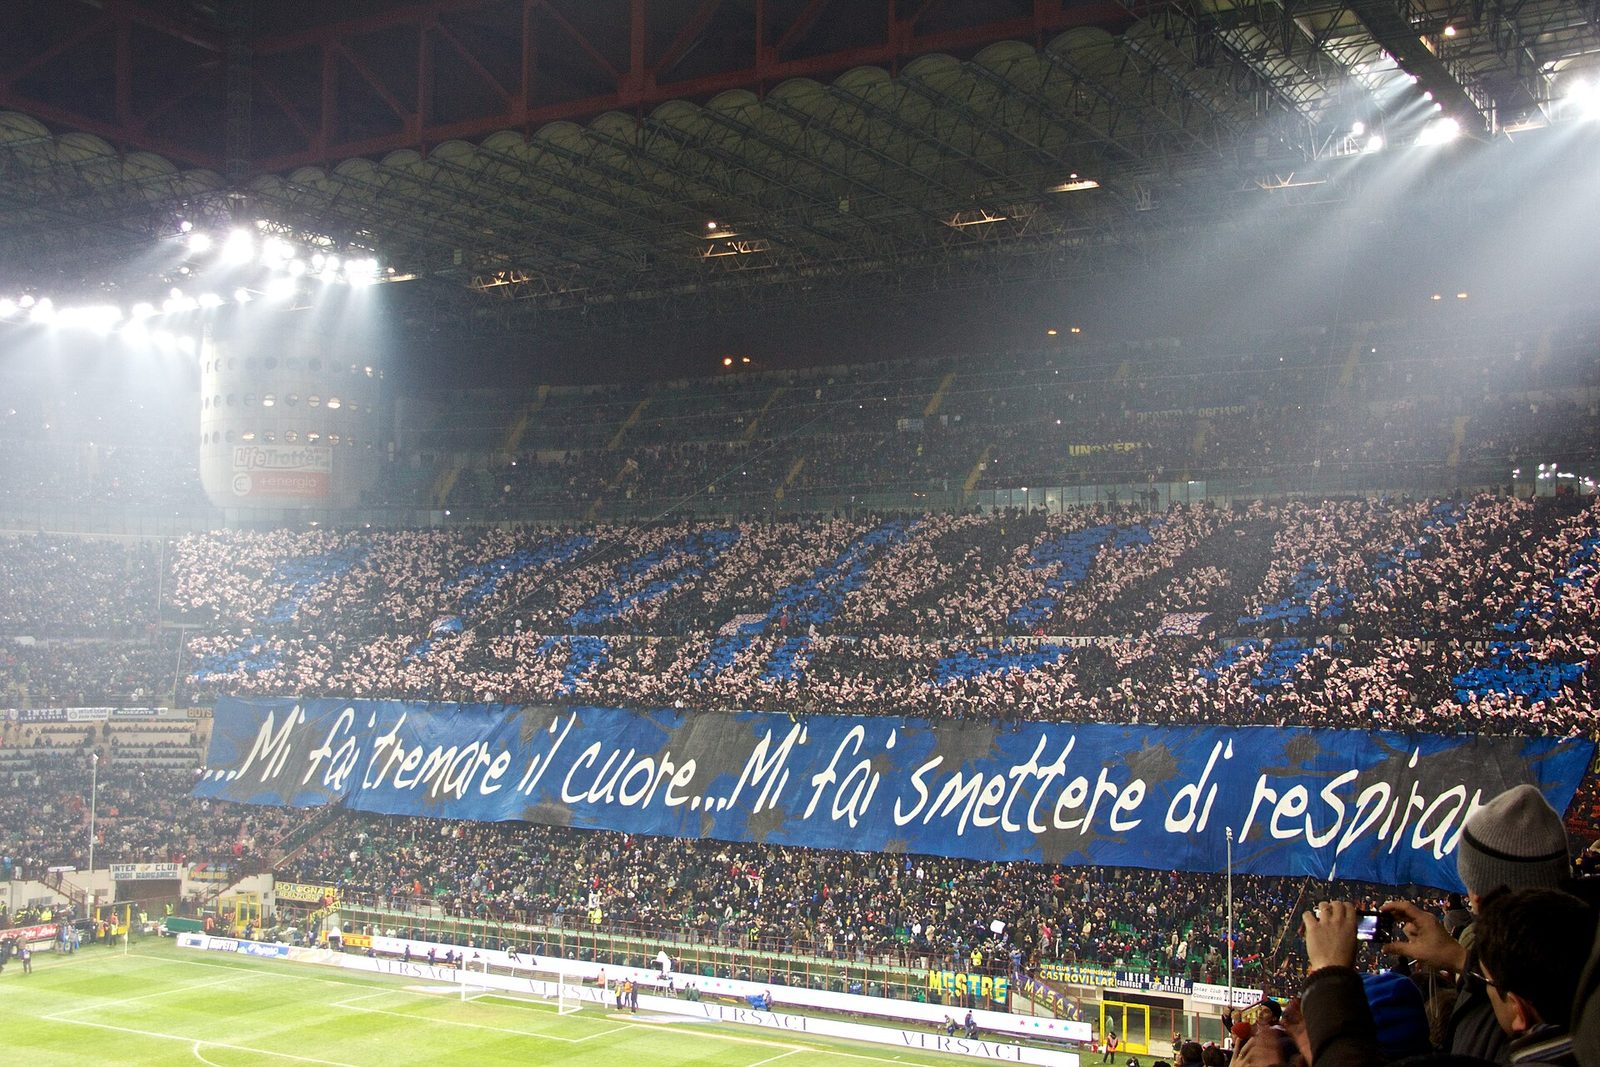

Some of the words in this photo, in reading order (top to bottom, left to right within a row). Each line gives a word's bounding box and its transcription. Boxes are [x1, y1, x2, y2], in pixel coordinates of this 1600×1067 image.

[188, 707, 213, 718] BOYS
[302, 708, 376, 792] fai
[362, 712, 512, 800] tremare
[516, 712, 577, 797] il
[803, 725, 897, 829] fai
[1164, 738, 1234, 834] di
[1239, 747, 1488, 881] respirar
[155, 863, 178, 871] CLUB
[276, 883, 324, 895] BOLOGNA
[1125, 972, 1150, 983] INTER
[1164, 976, 1185, 987] CLUB
[929, 969, 1007, 1004] MESTRE
